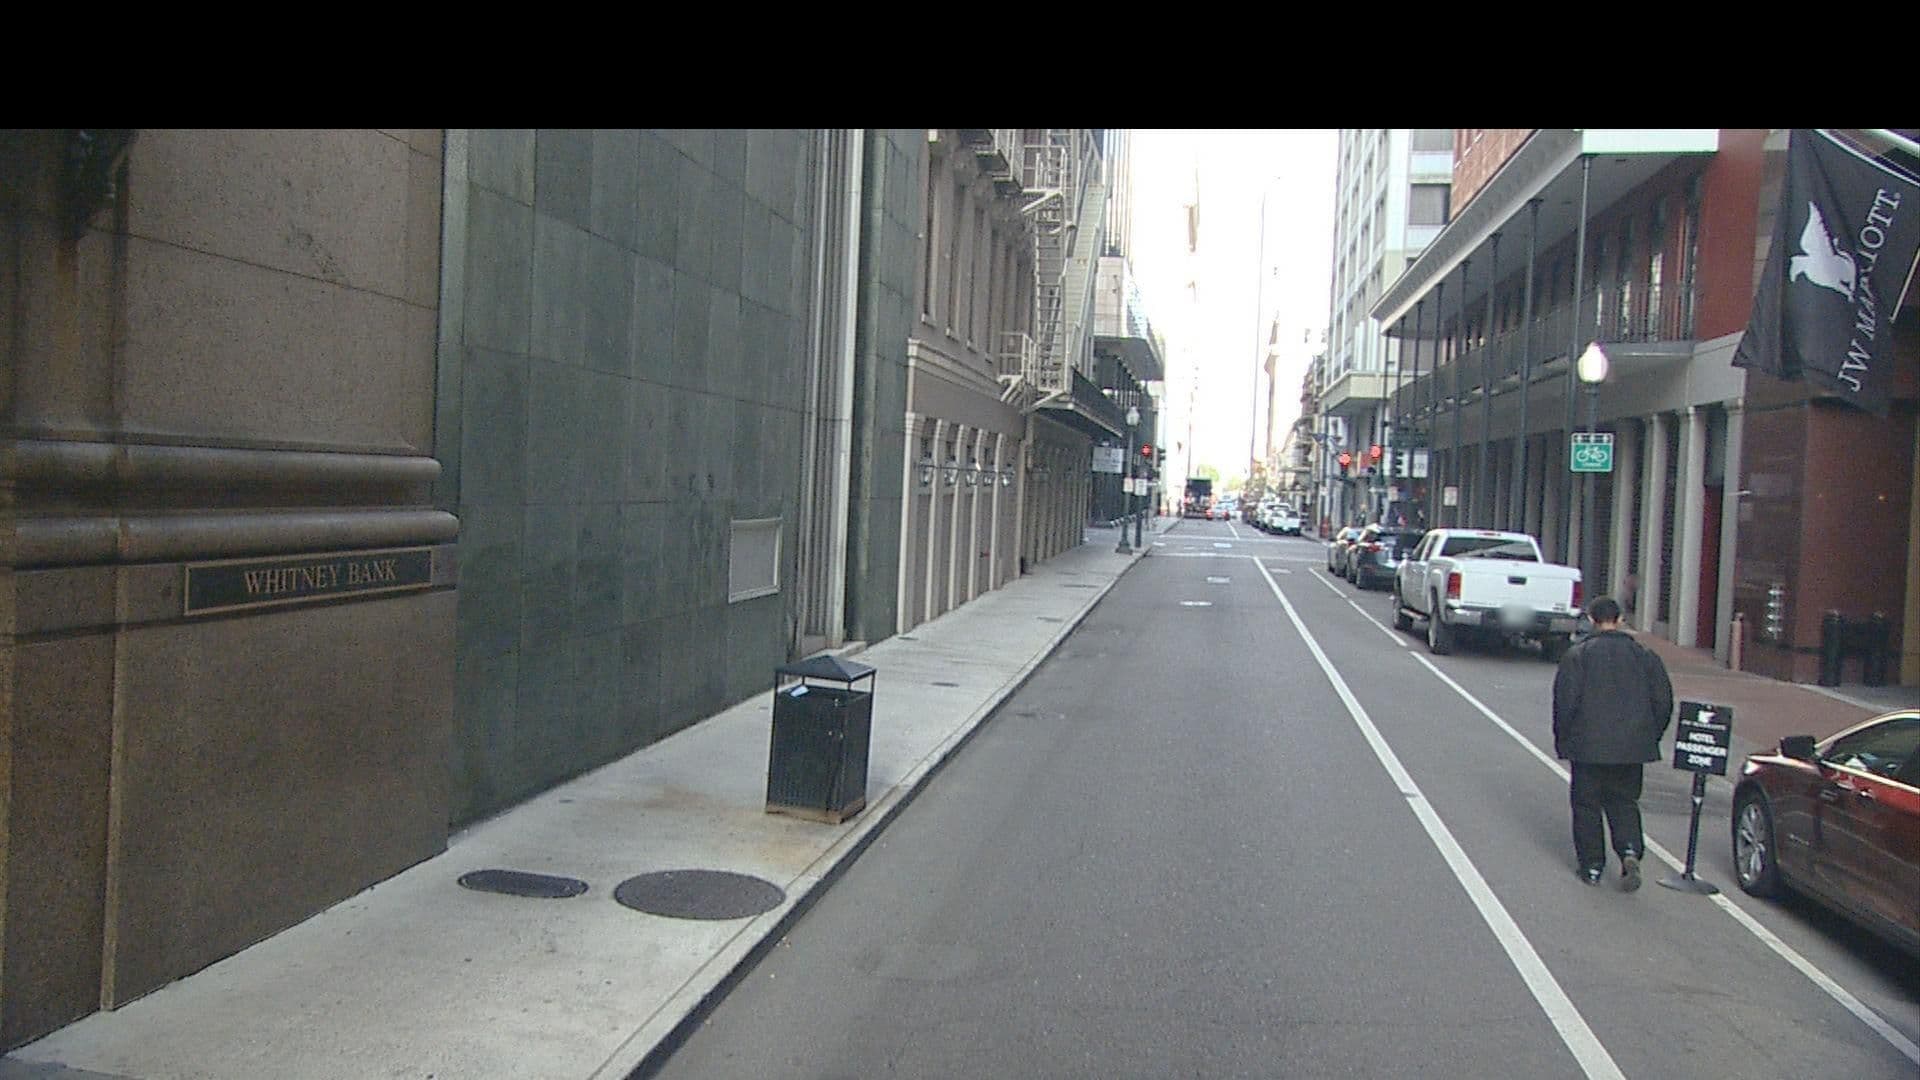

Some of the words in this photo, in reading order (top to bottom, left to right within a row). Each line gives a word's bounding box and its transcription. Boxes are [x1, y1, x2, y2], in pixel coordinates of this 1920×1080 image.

[1838, 339, 1873, 392] JW
[244, 565, 337, 594] WHITNEY
[350, 560, 396, 585] BANK
[1689, 732, 1715, 744] HOTEL
[1676, 741, 1727, 757] PASSENGER
[1687, 754, 1712, 767] ZONE
